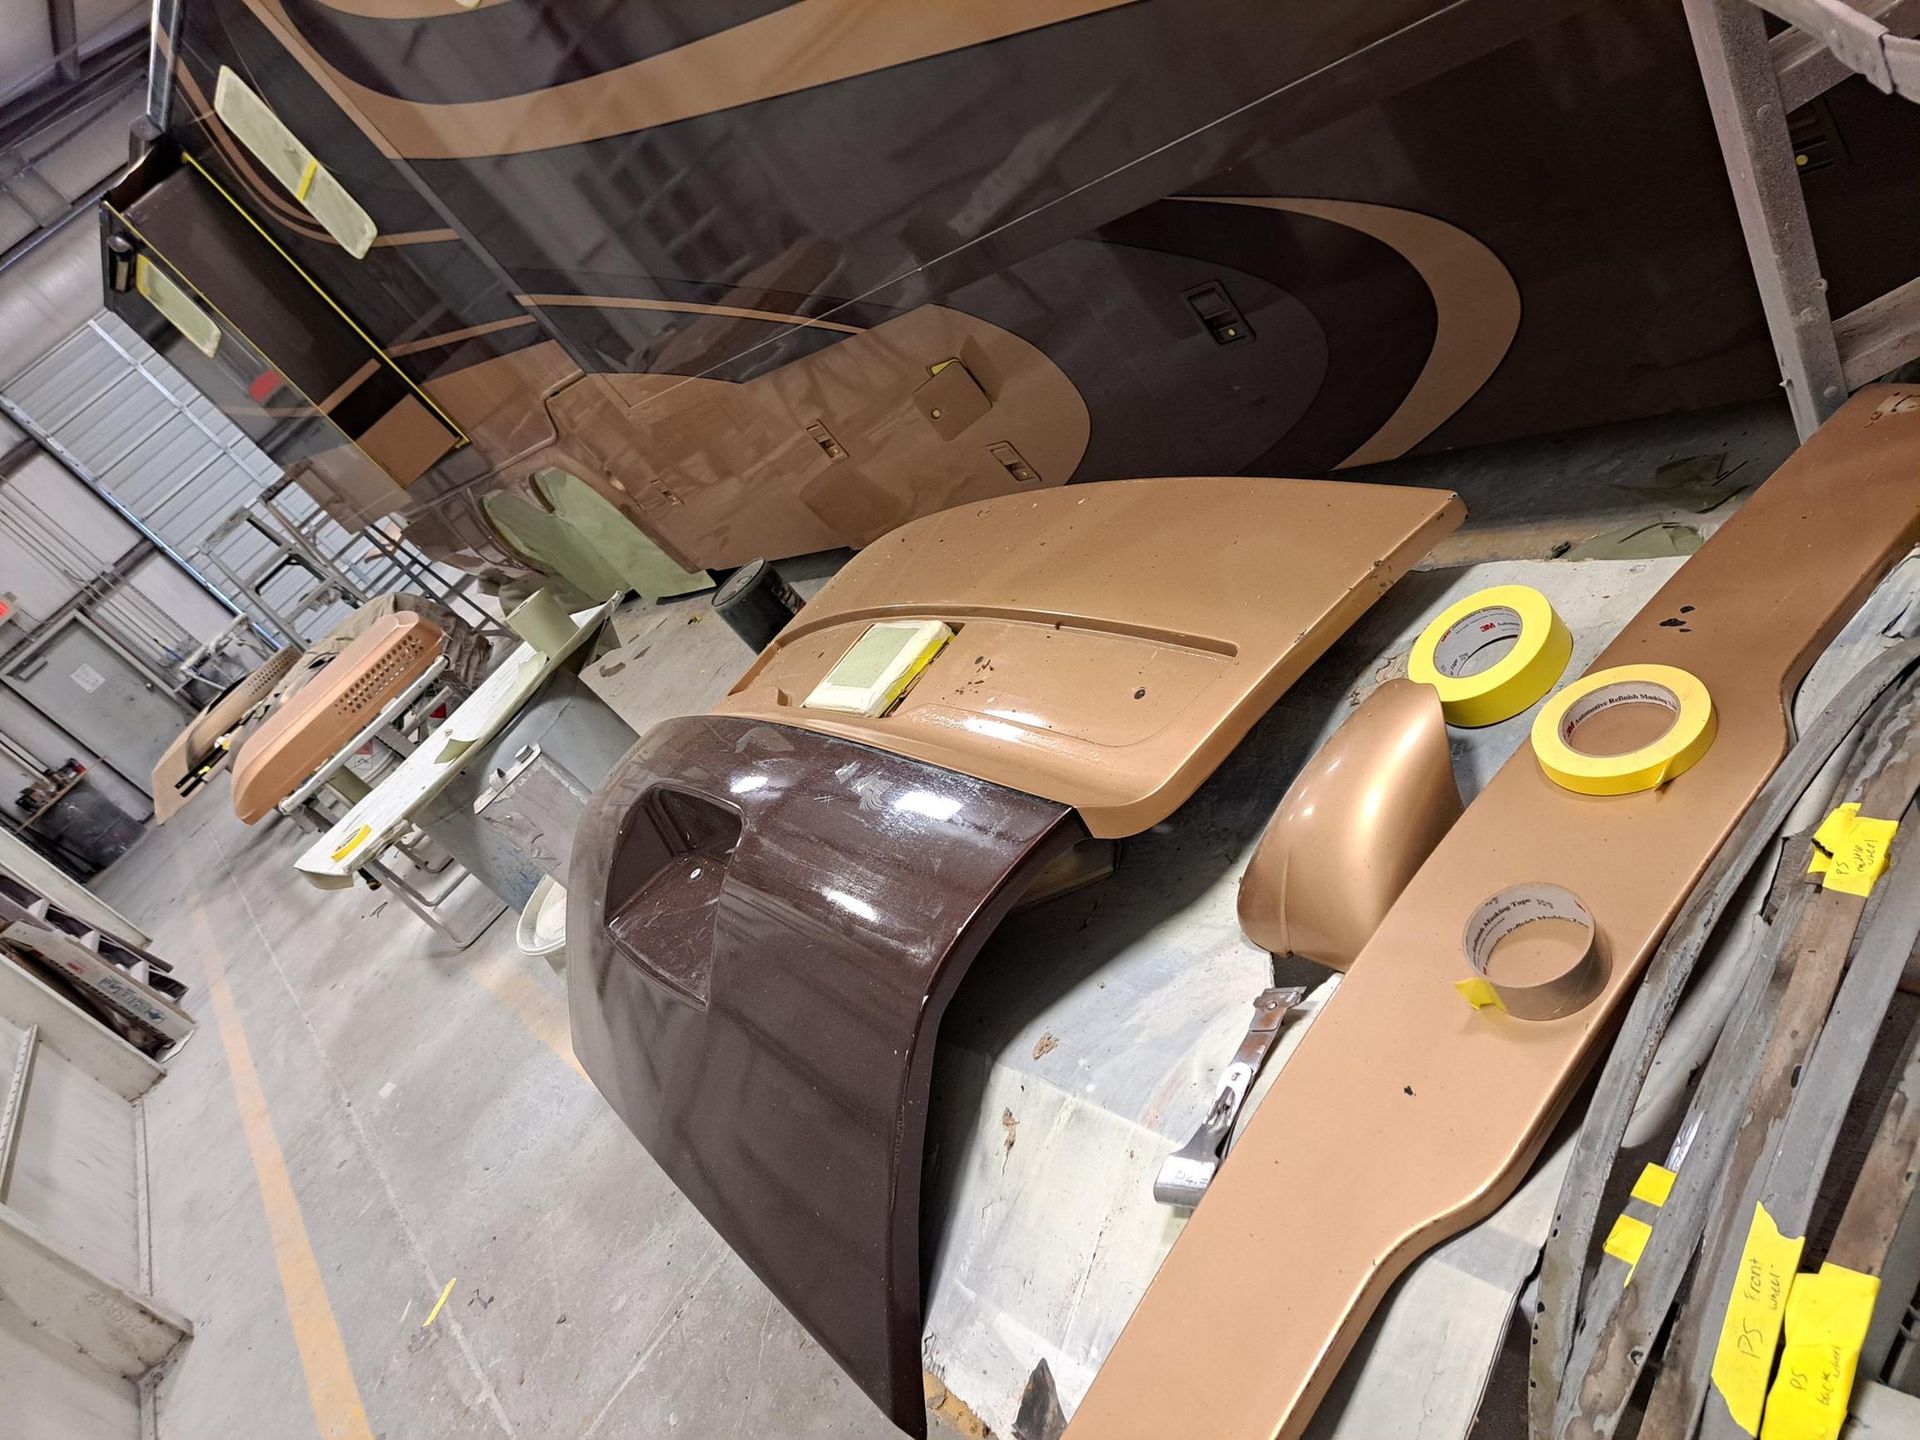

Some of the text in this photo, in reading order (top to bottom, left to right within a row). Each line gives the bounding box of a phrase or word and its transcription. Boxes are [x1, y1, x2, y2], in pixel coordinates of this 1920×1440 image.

[1479, 622, 1496, 633] 3M
[1574, 699, 1607, 725] Automotive
[1608, 693, 1639, 706] Refinish
[1483, 905, 1511, 929] Masking
[1512, 898, 1532, 908] Tape
[1737, 1318, 1764, 1359] PS
